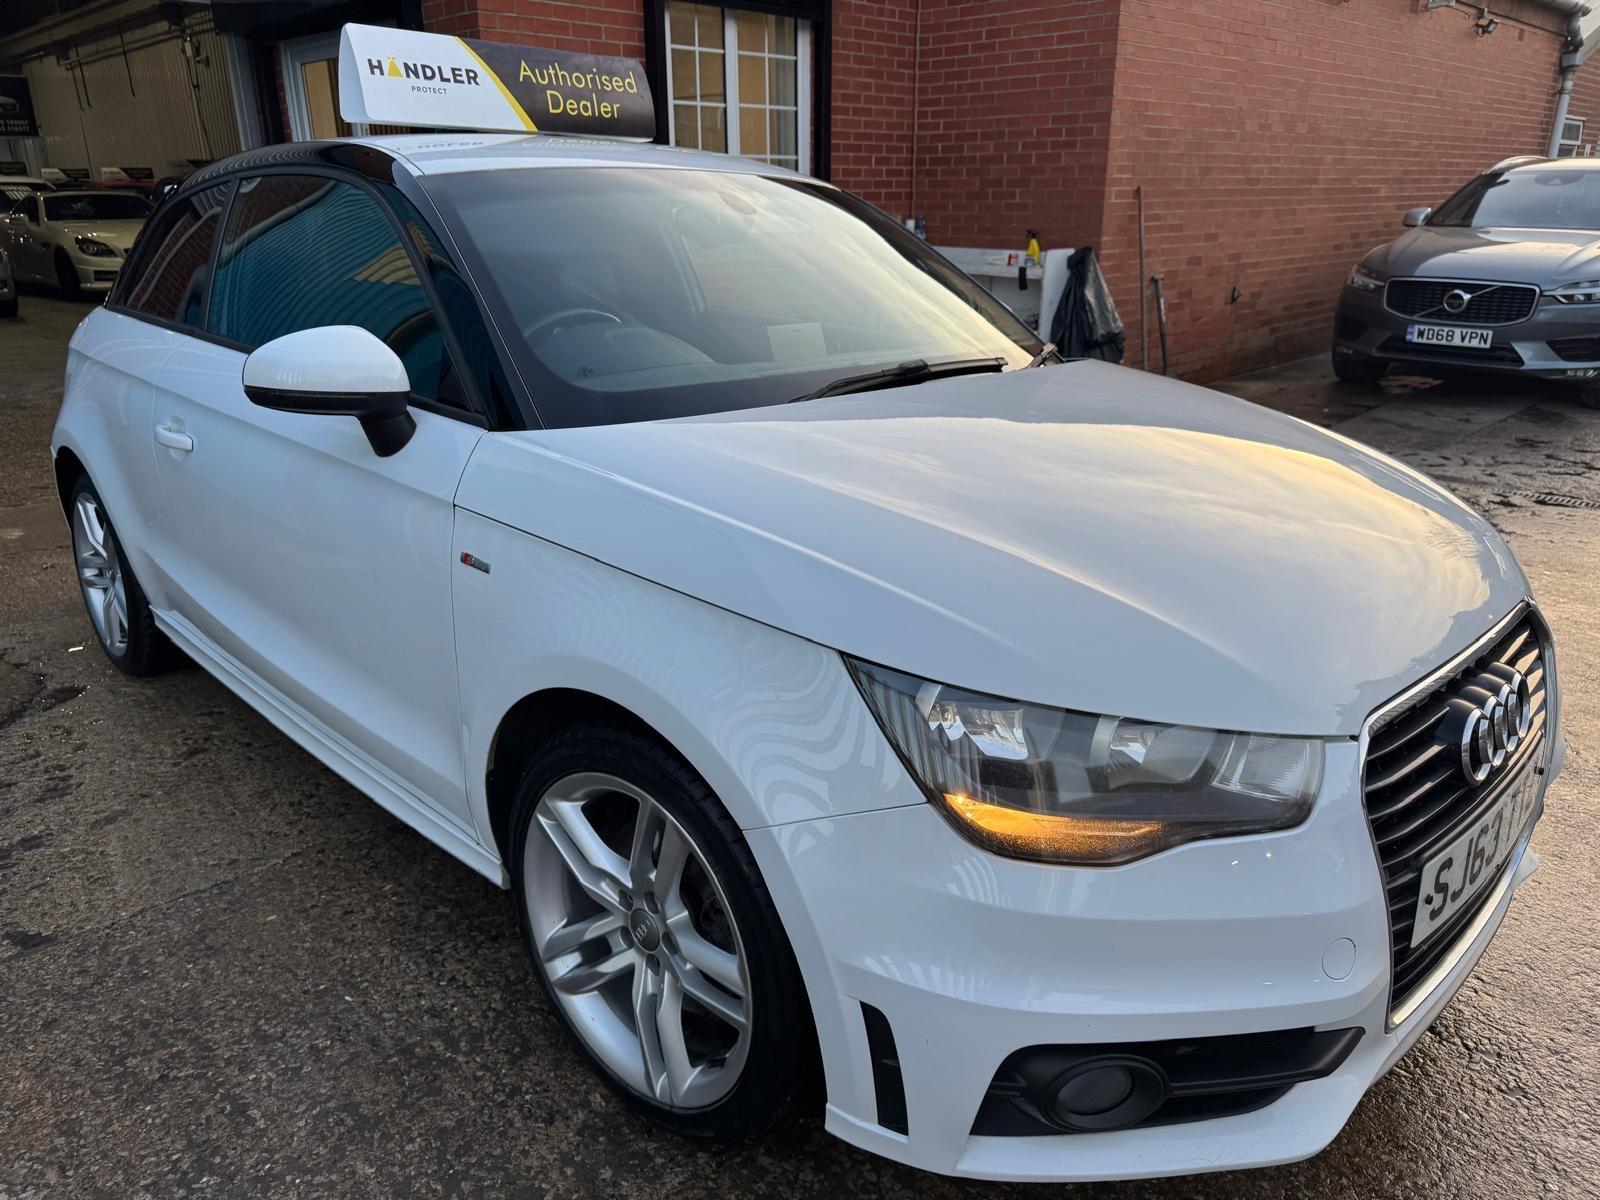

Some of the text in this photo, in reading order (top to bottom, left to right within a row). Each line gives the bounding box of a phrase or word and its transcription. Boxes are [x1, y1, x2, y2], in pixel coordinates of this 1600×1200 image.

[411, 85, 448, 95] PROTECT
[519, 59, 638, 94] Authorised
[546, 89, 620, 119] Dealer
[1416, 327, 1489, 345] WD68 VPN
[1429, 808, 1503, 921] SJ63
